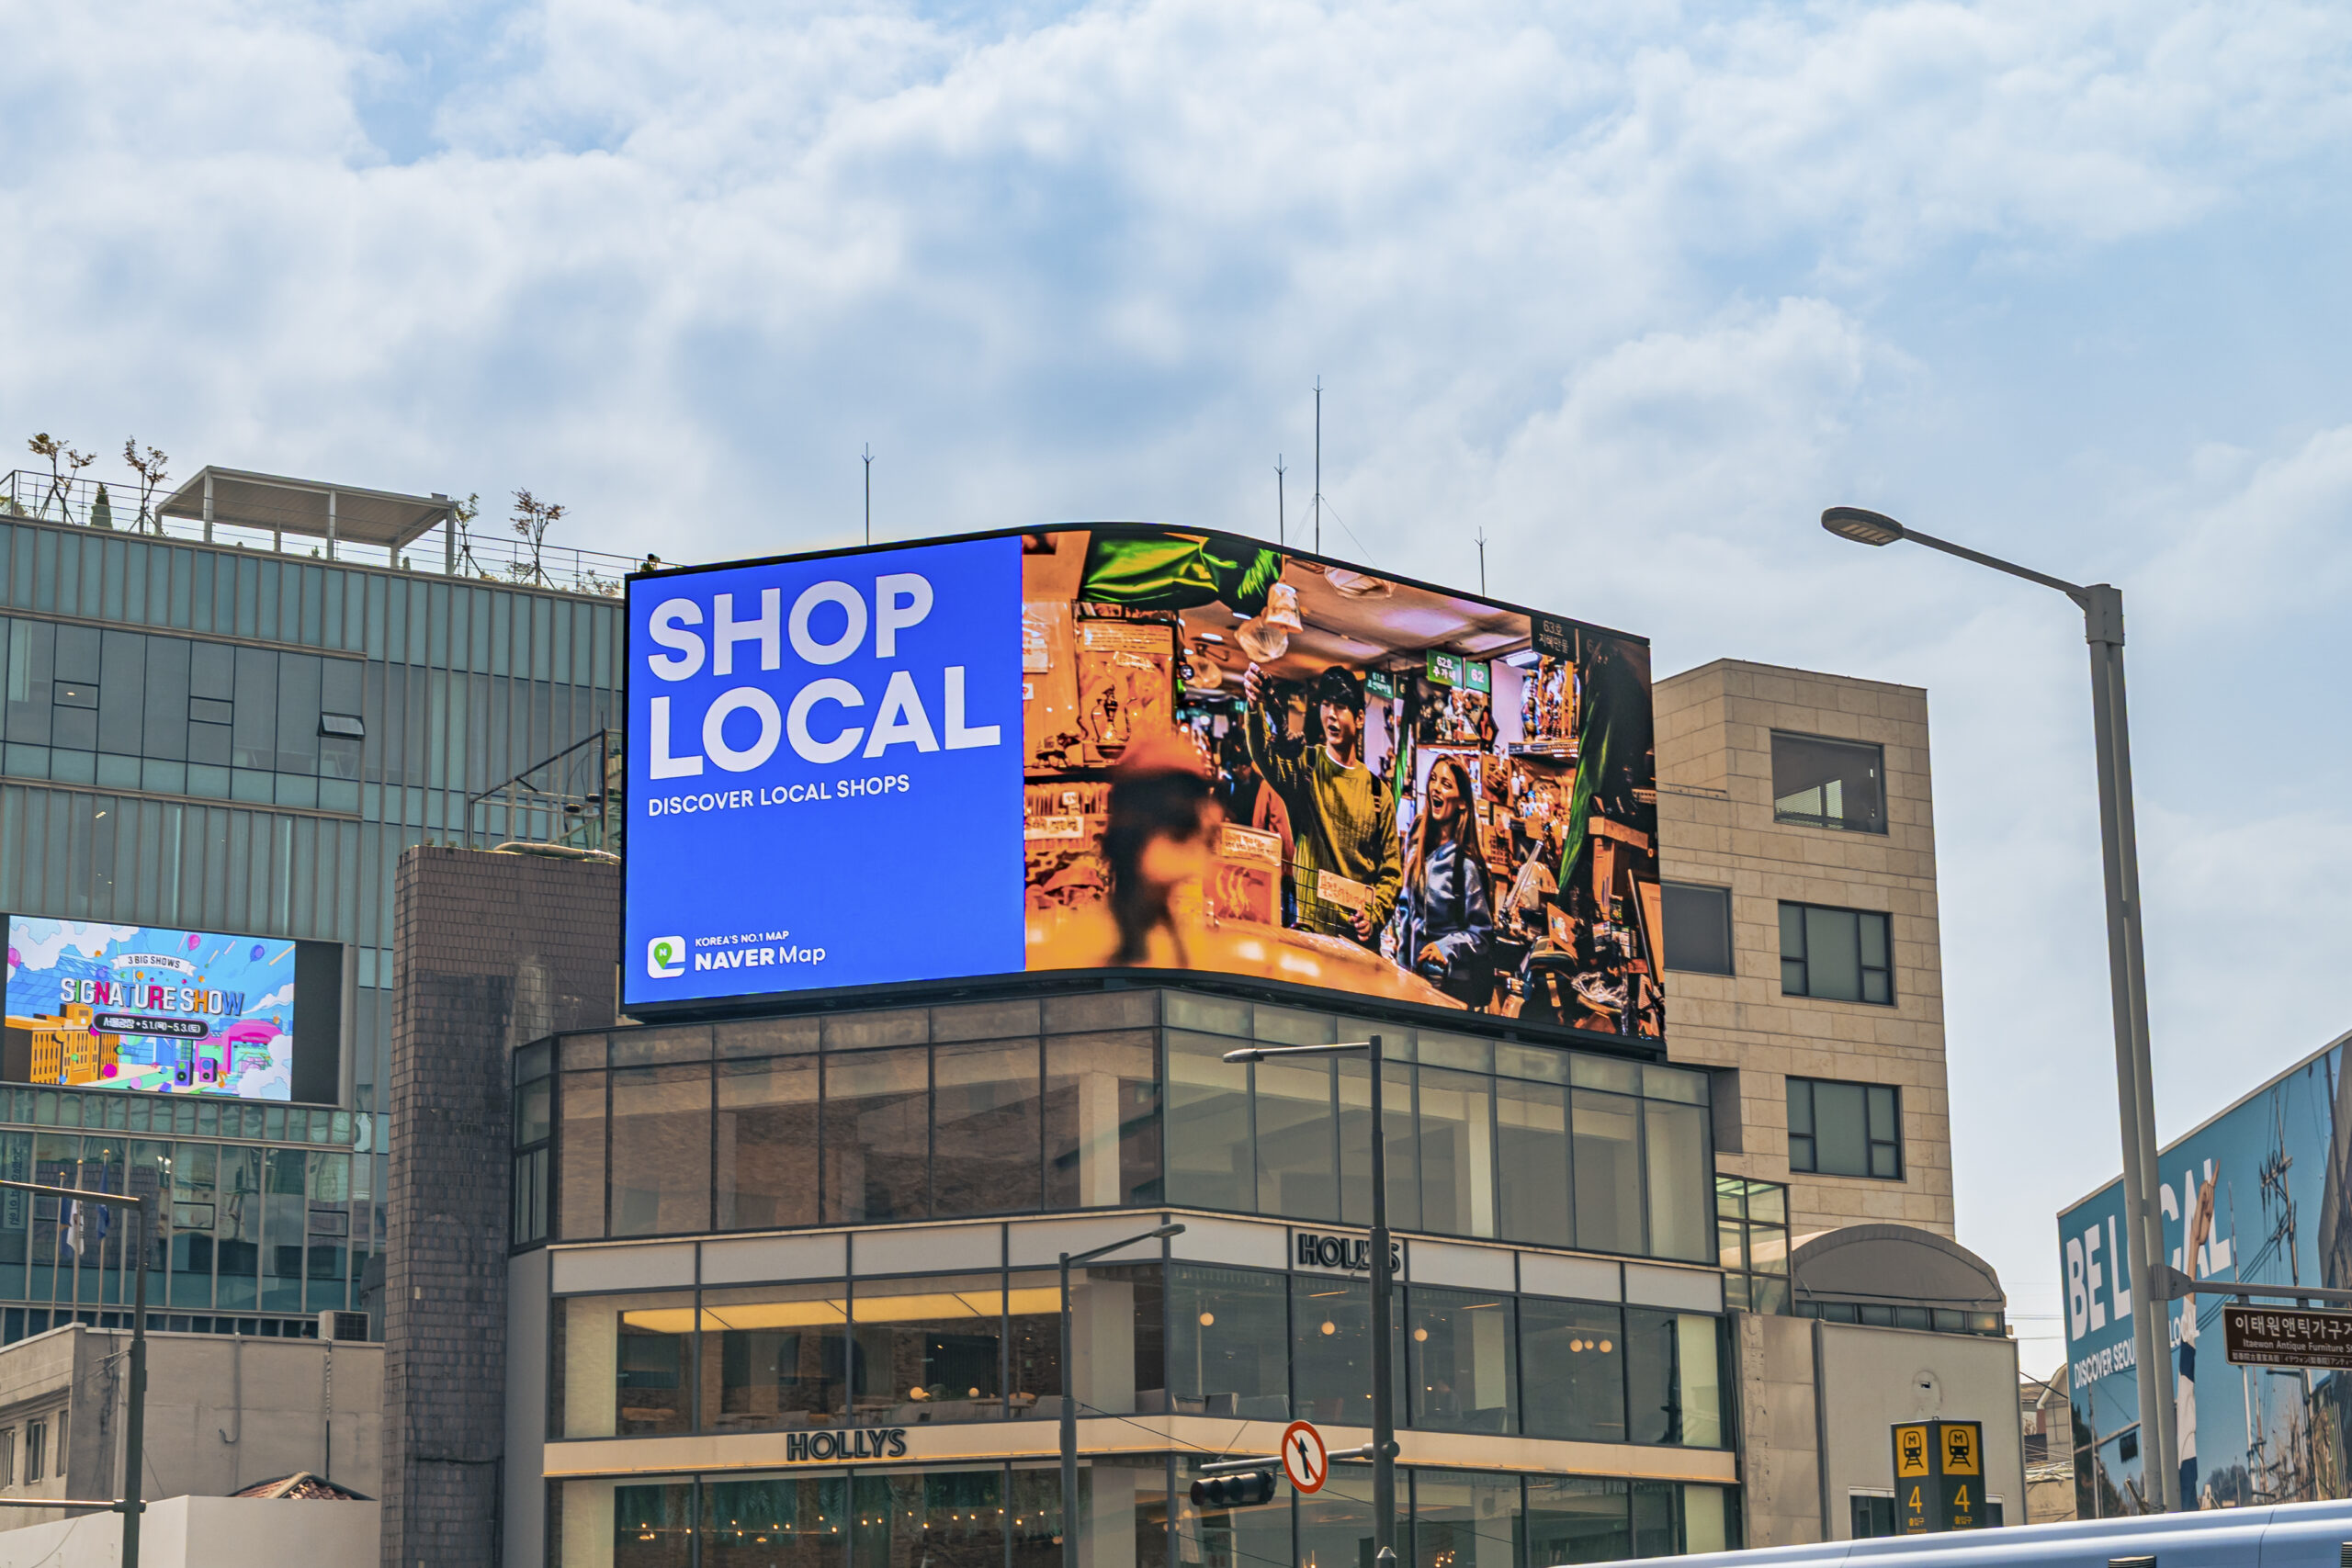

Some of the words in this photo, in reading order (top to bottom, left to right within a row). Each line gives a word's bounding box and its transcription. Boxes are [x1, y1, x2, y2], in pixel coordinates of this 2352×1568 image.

[648, 572, 933, 682] SHOP
[1470, 669, 1485, 683] 62
[650, 665, 1001, 780] LOCAL
[649, 790, 754, 817] DISCOVER
[761, 784, 831, 807] LOCAL
[836, 774, 910, 798] SHOPS
[695, 935, 739, 947] KOREA'S
[741, 932, 763, 944] NO.1
[765, 931, 790, 942] MAP
[128, 956, 134, 964] 3
[134, 956, 149, 964] BIG
[150, 956, 181, 969] SHOWS
[695, 947, 775, 971] NAVER
[779, 945, 826, 965] Map
[60, 977, 177, 1011] SIGNATURE
[179, 987, 245, 1017] SHOW
[1298, 1233, 1401, 1273] HOLLS
[2066, 1224, 2107, 1341] BE
[2108, 1158, 2232, 1321] LCAL
[2243, 1338, 2274, 1349] Itaewon
[2277, 1340, 2307, 1352] Antique
[2308, 1342, 2344, 1353] Furniture
[2346, 1344, 2352, 1353] S
[2074, 1348, 2113, 1390] DISCOVER
[2113, 1337, 2136, 1371] SEOU
[786, 1428, 908, 1461] HOLLYS
[1908, 1435, 1917, 1445] M
[1954, 1433, 1963, 1443] M
[1908, 1485, 1922, 1514] 4
[1953, 1484, 1971, 1513] 4
